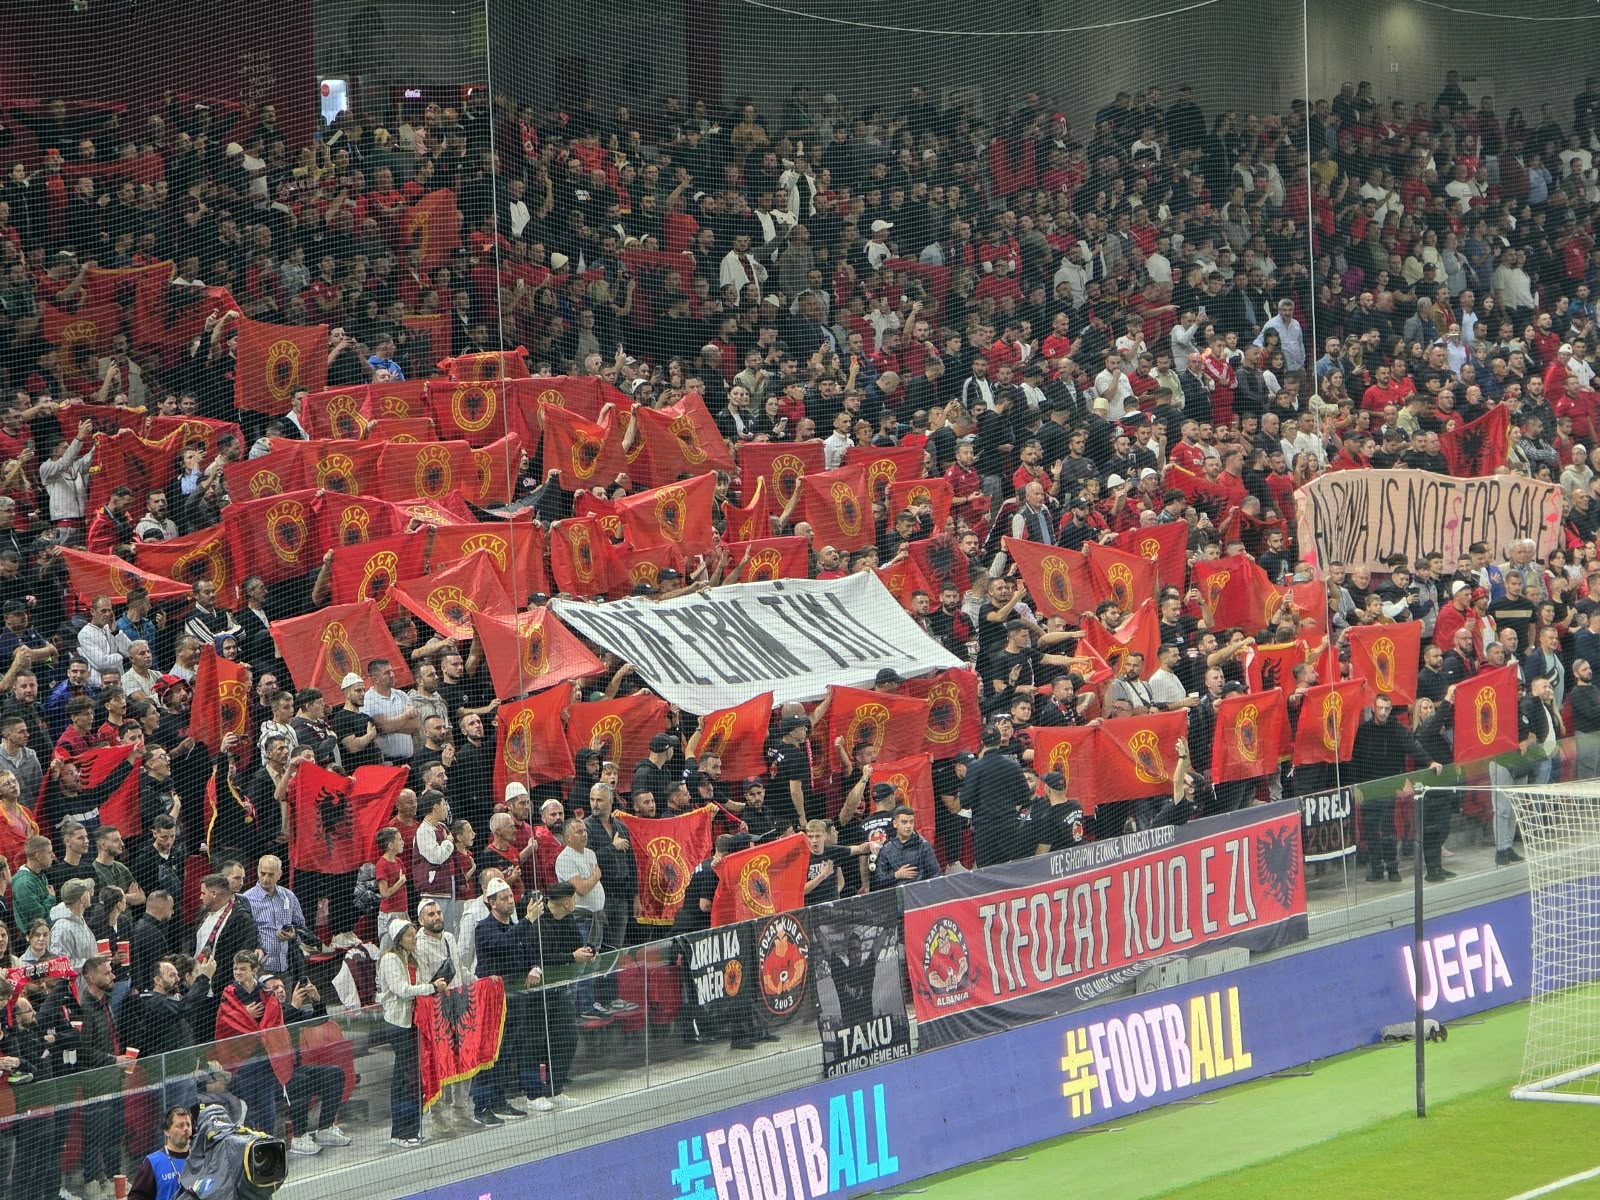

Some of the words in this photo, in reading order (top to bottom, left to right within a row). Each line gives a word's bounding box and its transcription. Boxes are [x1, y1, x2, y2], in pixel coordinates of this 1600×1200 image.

[1403, 478, 1456, 562] NOT
[1459, 479, 1500, 561] FOR
[1503, 482, 1554, 564] SALE
[1306, 790, 1350, 826] PREJ
[1050, 856, 1064, 878] VEÇ
[1096, 839, 1122, 865] ETNIKE,
[979, 876, 1112, 996] TIFOZAT
[1122, 855, 1193, 960] KUQ
[1200, 846, 1218, 935] E
[1225, 837, 1257, 928] ZI
[690, 934, 721, 971] LIRIA
[722, 929, 740, 960] KA
[1403, 923, 1513, 1011] UEFA
[694, 966, 724, 1006] MËR
[774, 995, 794, 1010] 2003
[936, 991, 969, 1006] ALBANIA
[837, 1016, 892, 1057] TAKU
[892, 1043, 909, 1058] NE!
[1061, 986, 1253, 1119] #FOOTBALL
[671, 1083, 899, 1200] #FOOTBALL
